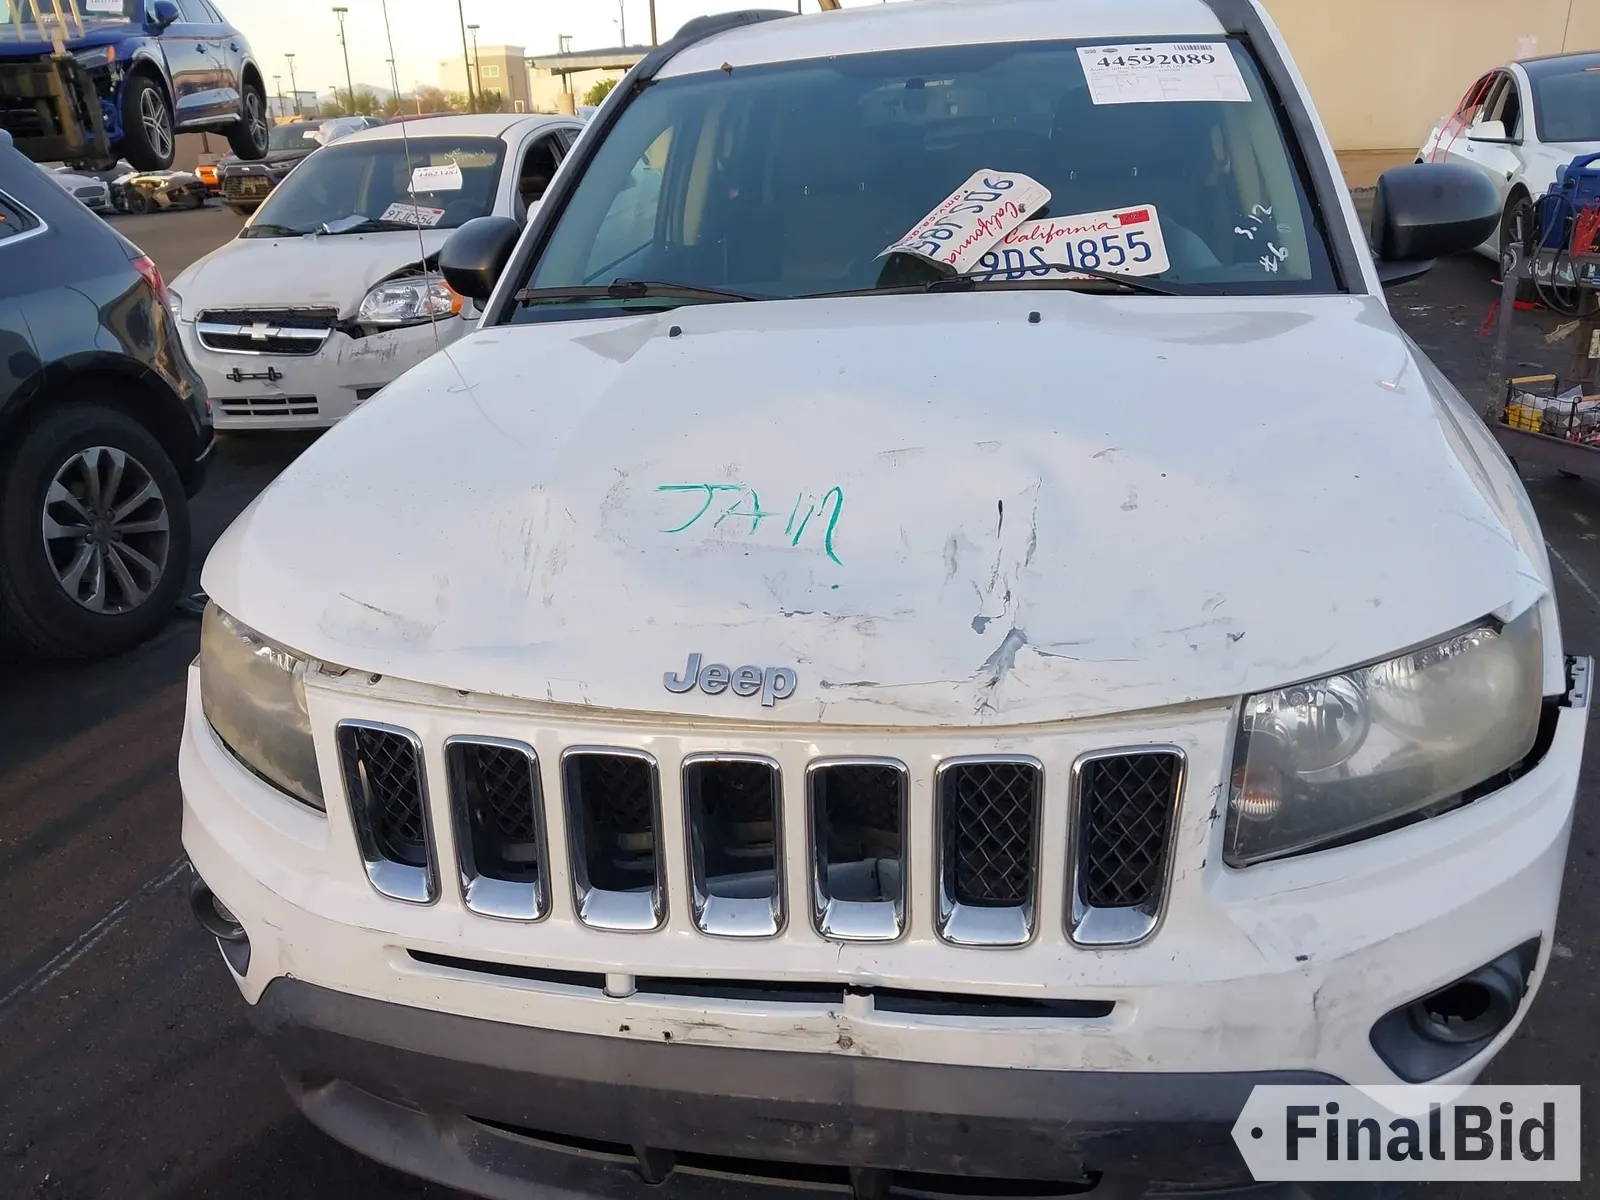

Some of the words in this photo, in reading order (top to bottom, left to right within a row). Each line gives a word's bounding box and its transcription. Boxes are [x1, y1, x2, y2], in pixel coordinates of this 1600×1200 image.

[1097, 53, 1216, 67] 44592089
[893, 177, 1014, 258] 9DSJ85
[941, 201, 1019, 264] California
[1004, 219, 1112, 246] California
[663, 652, 798, 707] Jeep
